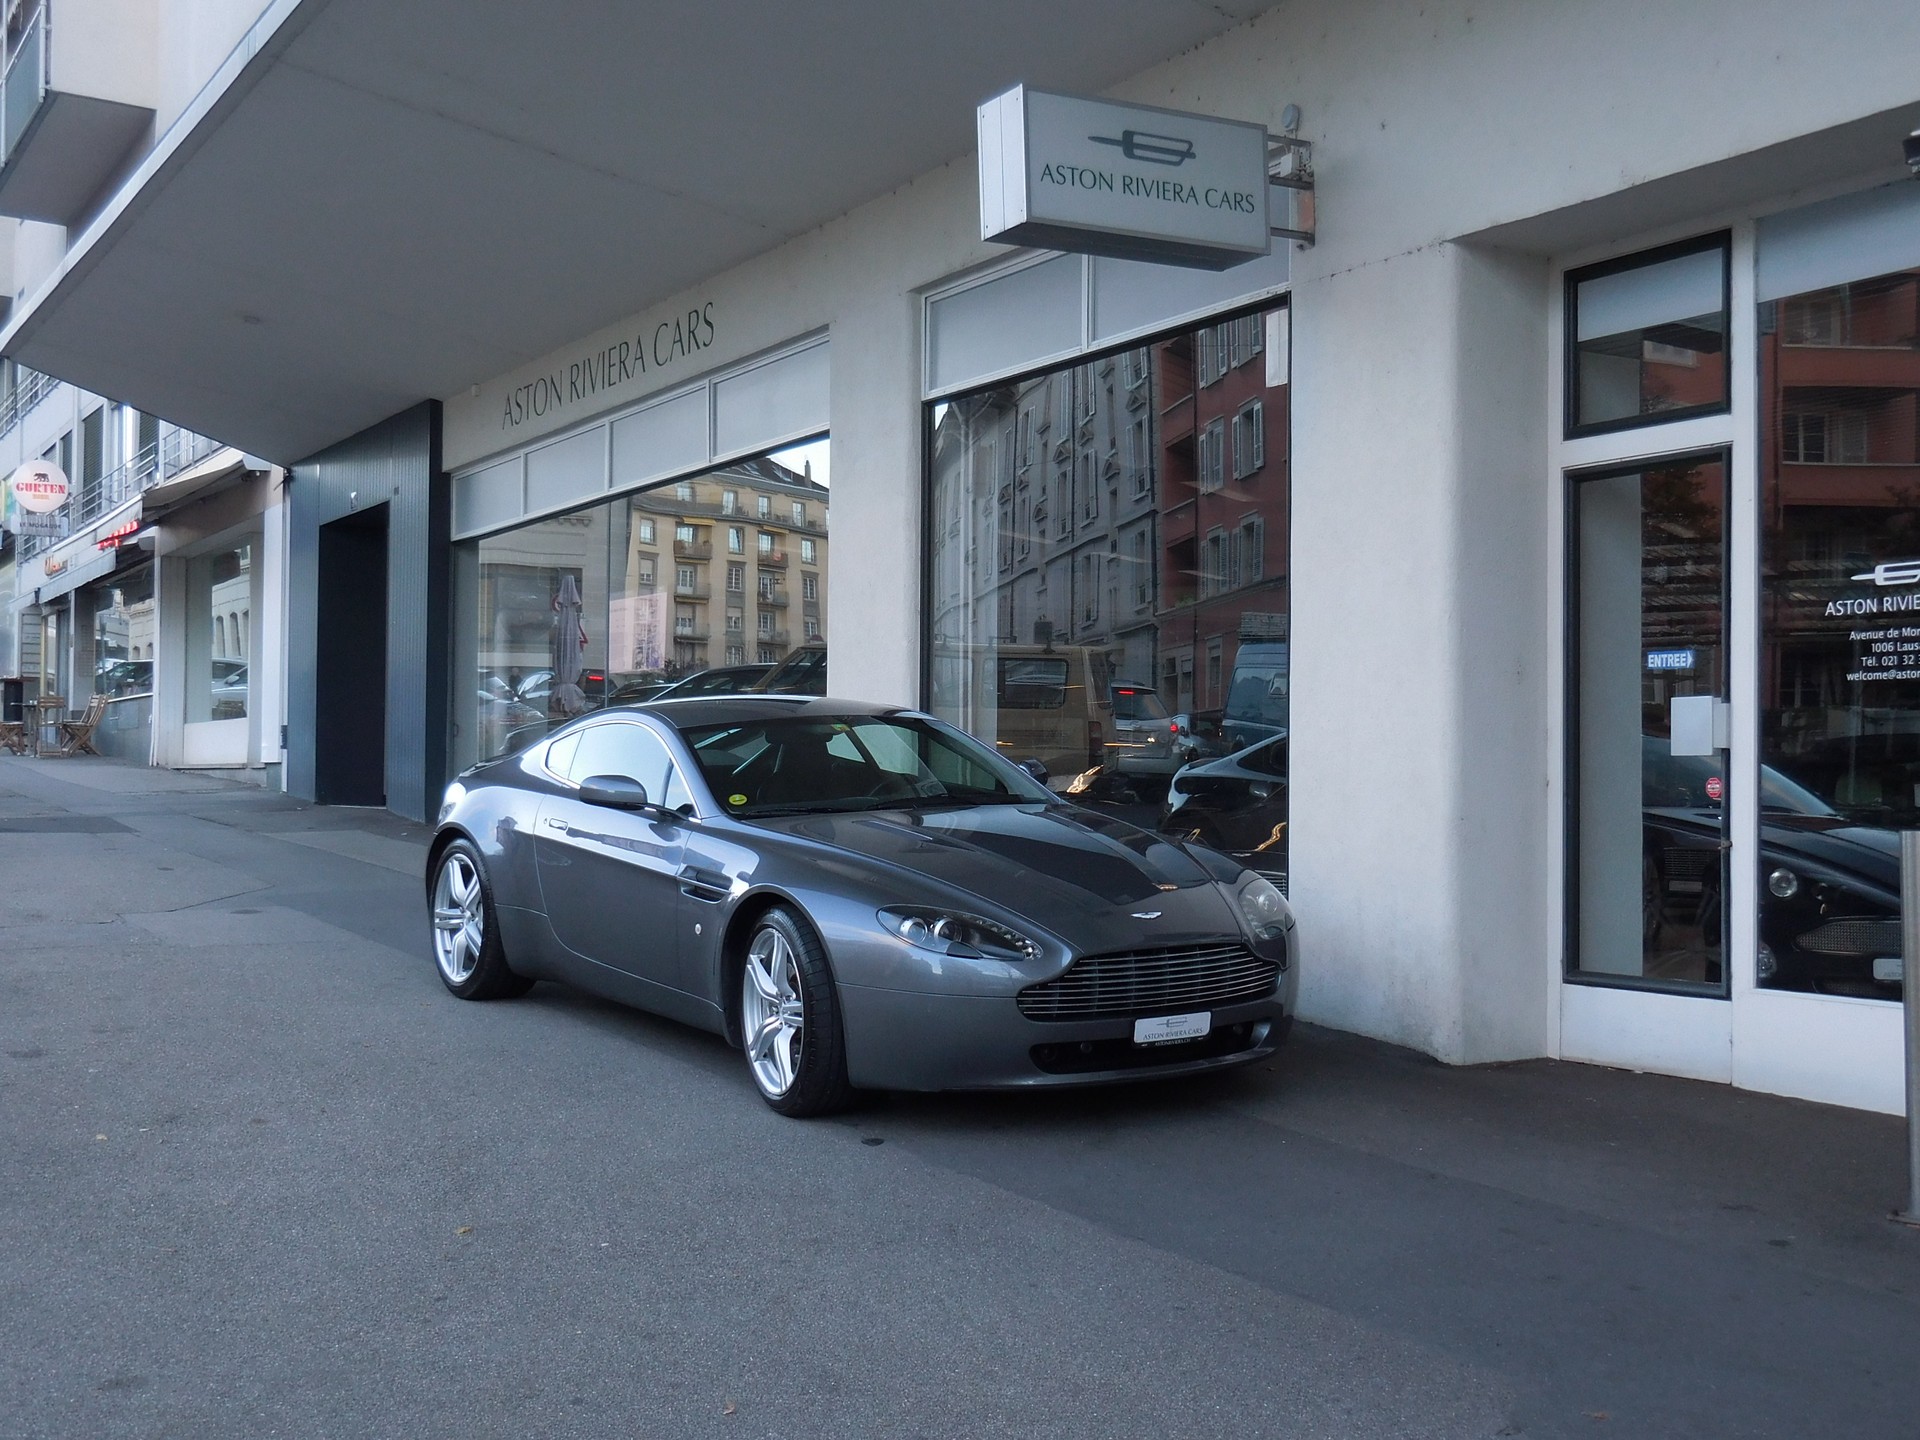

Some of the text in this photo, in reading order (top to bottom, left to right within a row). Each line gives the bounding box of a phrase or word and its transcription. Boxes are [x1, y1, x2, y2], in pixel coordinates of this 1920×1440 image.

[1040, 163, 1256, 214] ASTON RIVIERA CARS
[502, 301, 715, 430] ASTON RIVIERA CARS
[16, 483, 66, 494] GURTEN
[1824, 598, 1877, 616] ASTON
[1848, 631, 1884, 640] Avenue
[1886, 628, 1899, 638] de
[1871, 642, 1920, 653] 1006 Laus
[1648, 653, 1686, 668] ENTREE
[1860, 656, 1879, 667] Tél.
[1881, 655, 1898, 666] 021
[1902, 654, 1915, 666] 32
[1143, 1027, 1203, 1040] ASTON RIVIERA CARS
